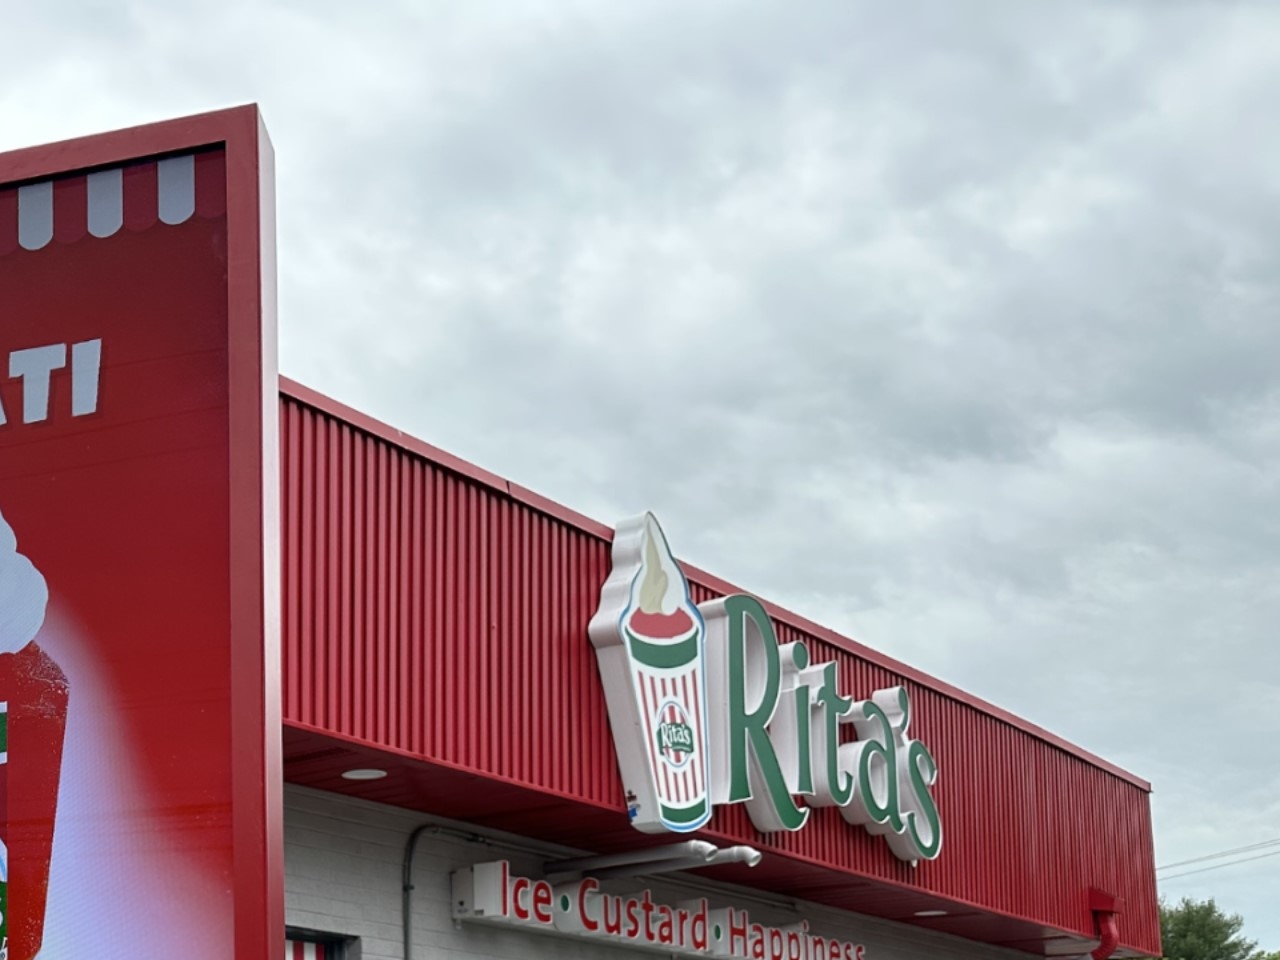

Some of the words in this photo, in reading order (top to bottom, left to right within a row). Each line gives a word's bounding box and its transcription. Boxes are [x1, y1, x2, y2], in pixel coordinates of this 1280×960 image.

[660, 722, 691, 747] Rita's
[723, 594, 943, 861] Rita's
[500, 860, 554, 923] Ice
[577, 877, 710, 952] Custard
